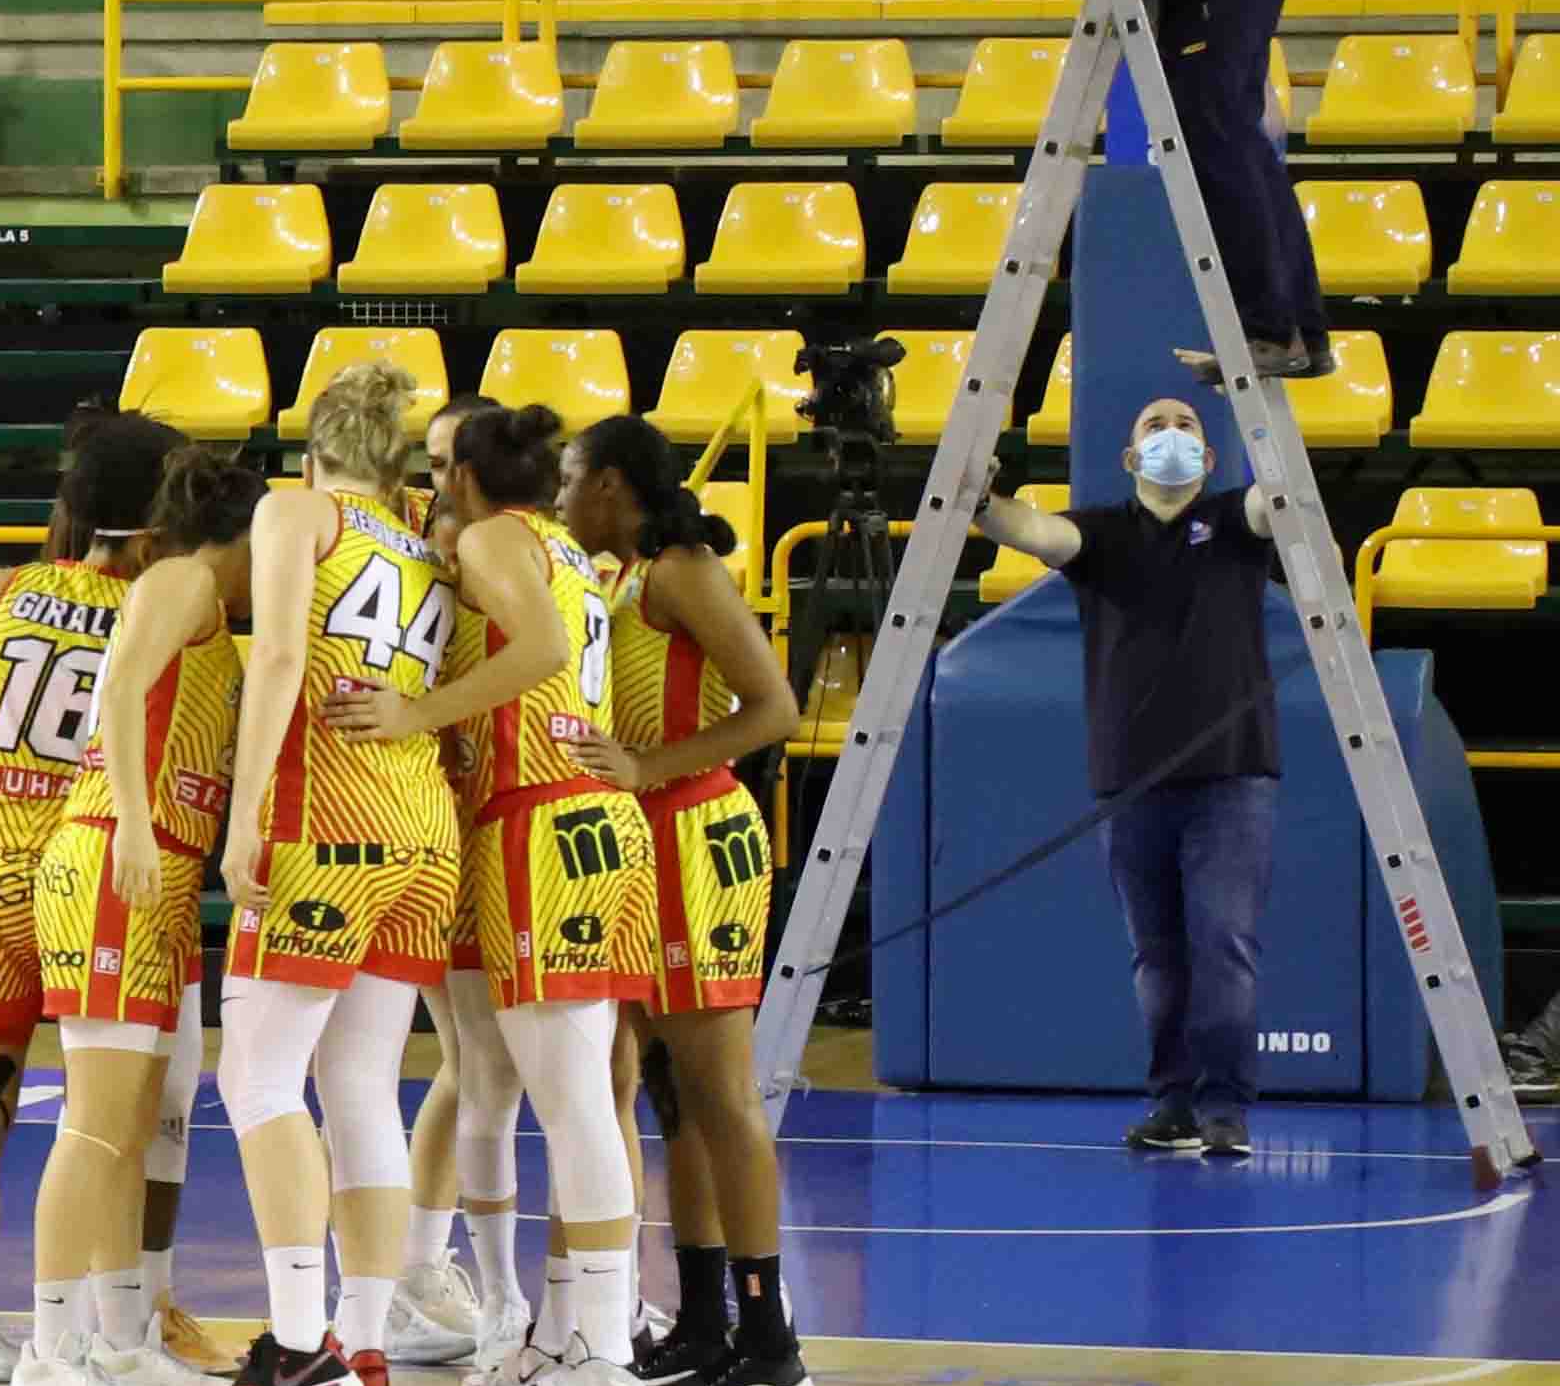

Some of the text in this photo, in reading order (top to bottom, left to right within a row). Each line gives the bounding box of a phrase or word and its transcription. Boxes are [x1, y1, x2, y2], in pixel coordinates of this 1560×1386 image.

[19, 229, 29, 243] 5
[10, 589, 119, 637] GIRAL
[324, 551, 458, 693] 44
[1257, 1032, 1331, 1053] NDO
